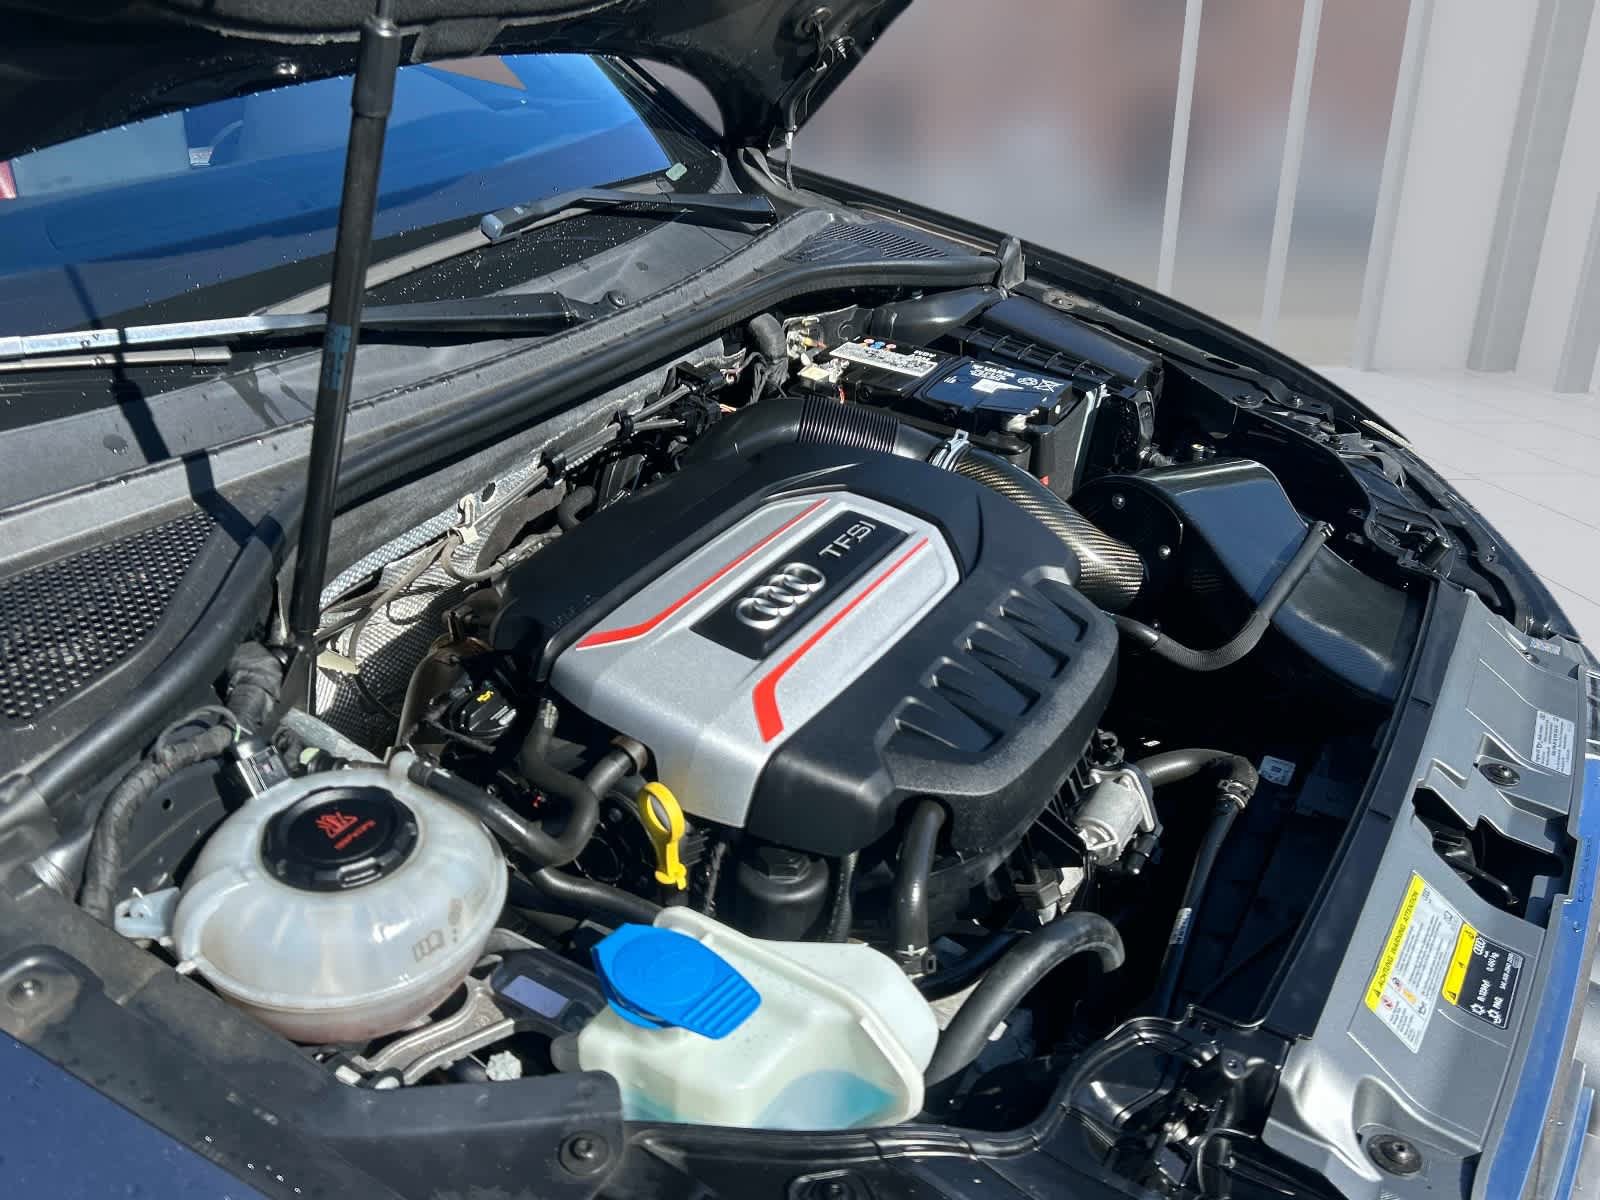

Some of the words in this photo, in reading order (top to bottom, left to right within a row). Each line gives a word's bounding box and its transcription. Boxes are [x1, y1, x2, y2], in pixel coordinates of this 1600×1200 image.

[819, 520, 876, 559] TFSI
[1377, 956, 1394, 988] ACHTUNG
[1391, 924, 1406, 954] WARNING
[1402, 891, 1419, 921] ATTENTION
